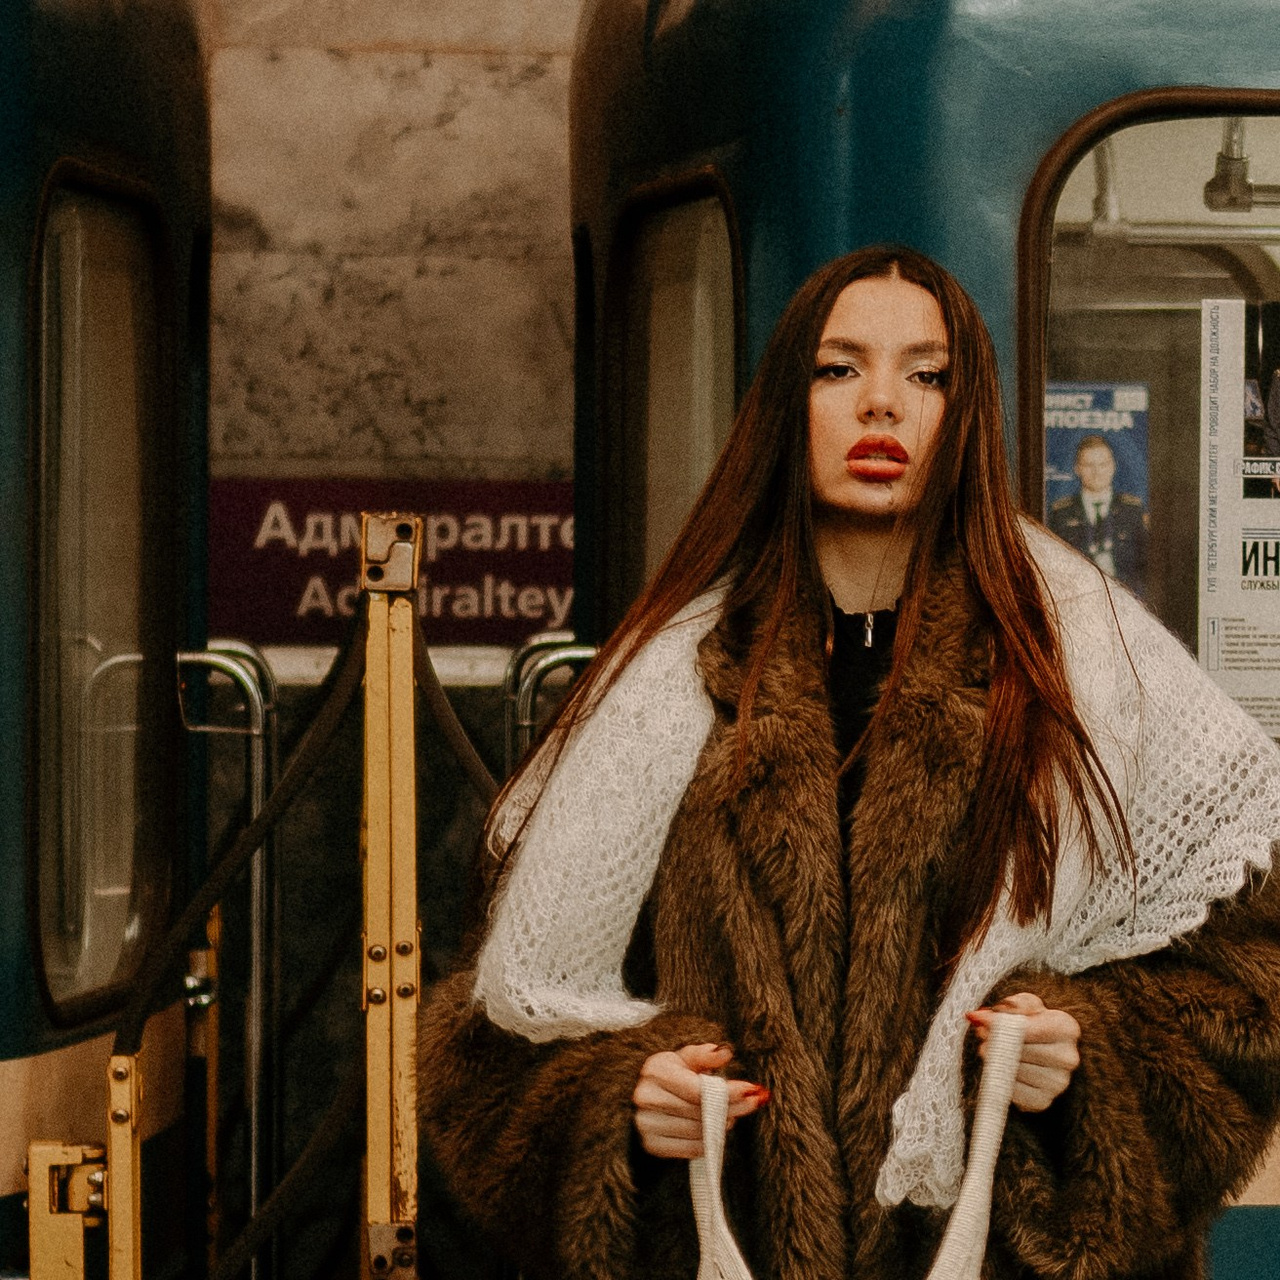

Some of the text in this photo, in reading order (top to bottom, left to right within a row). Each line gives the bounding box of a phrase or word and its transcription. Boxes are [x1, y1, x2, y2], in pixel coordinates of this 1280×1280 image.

[1209, 305, 1220, 355] ДОЛЖНОСТЬ
[1209, 356, 1219, 367] НА
[1209, 368, 1219, 394] НАБОР
[1209, 395, 1219, 437] ПРОВОДИТ
[1240, 580, 1280, 591] СЛУЖБЫ
[297, 575, 574, 628] Adiraltey
[1211, 620, 1216, 635] 1
